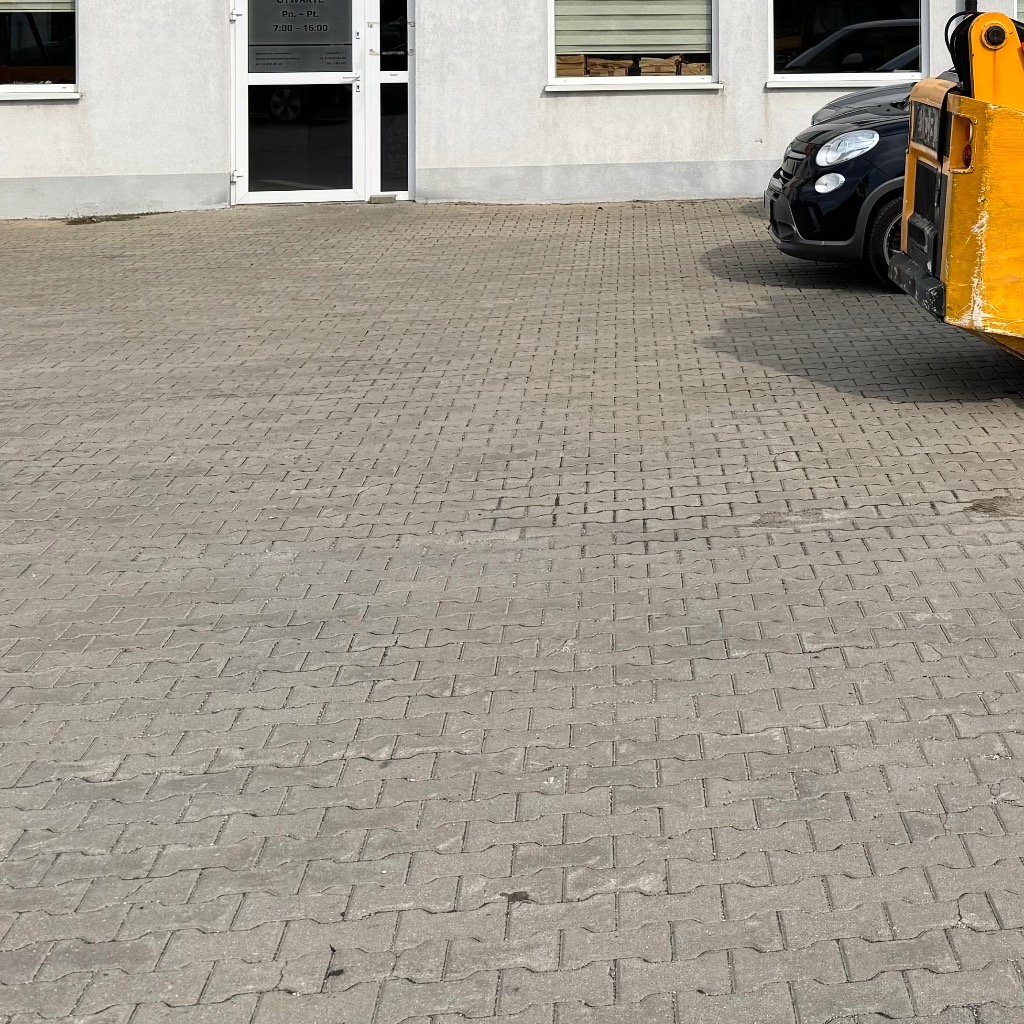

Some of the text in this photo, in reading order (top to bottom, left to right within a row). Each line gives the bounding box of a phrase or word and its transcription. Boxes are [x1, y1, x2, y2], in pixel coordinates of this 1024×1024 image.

[282, 10, 297, 18] Pn.
[306, 10, 320, 18] Pt.
[273, 24, 293, 32] 7:00
[303, 24, 328, 32] 16:00
